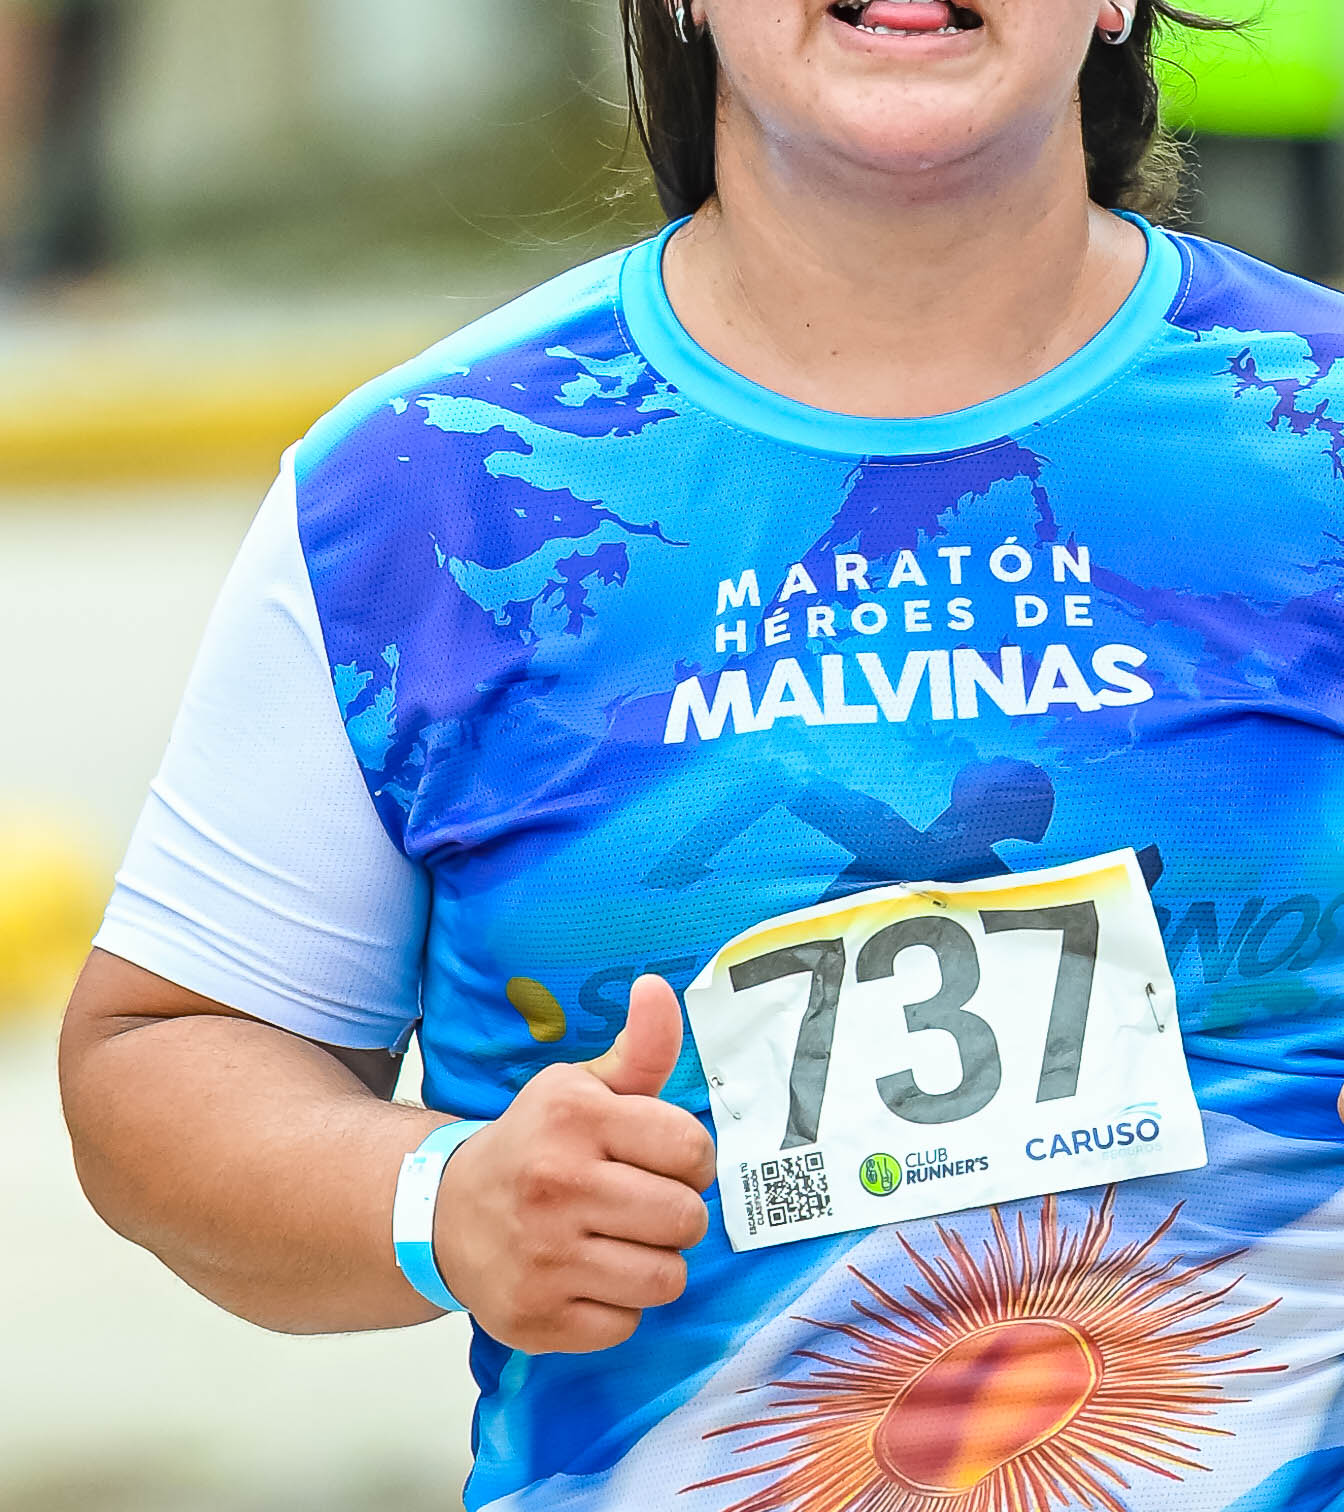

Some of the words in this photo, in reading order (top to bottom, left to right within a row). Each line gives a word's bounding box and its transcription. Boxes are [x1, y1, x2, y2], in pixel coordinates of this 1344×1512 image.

[715, 536, 1092, 615] MARATÓN
[715, 596, 975, 653] HÉROES
[1015, 594, 1094, 628] DE
[663, 643, 1155, 744] MALVINAS
[728, 900, 1099, 1151] 737
[905, 1147, 949, 1168] CLUB
[1025, 1118, 1160, 1161] CARUSO
[906, 1156, 989, 1185] RUNNER'S
